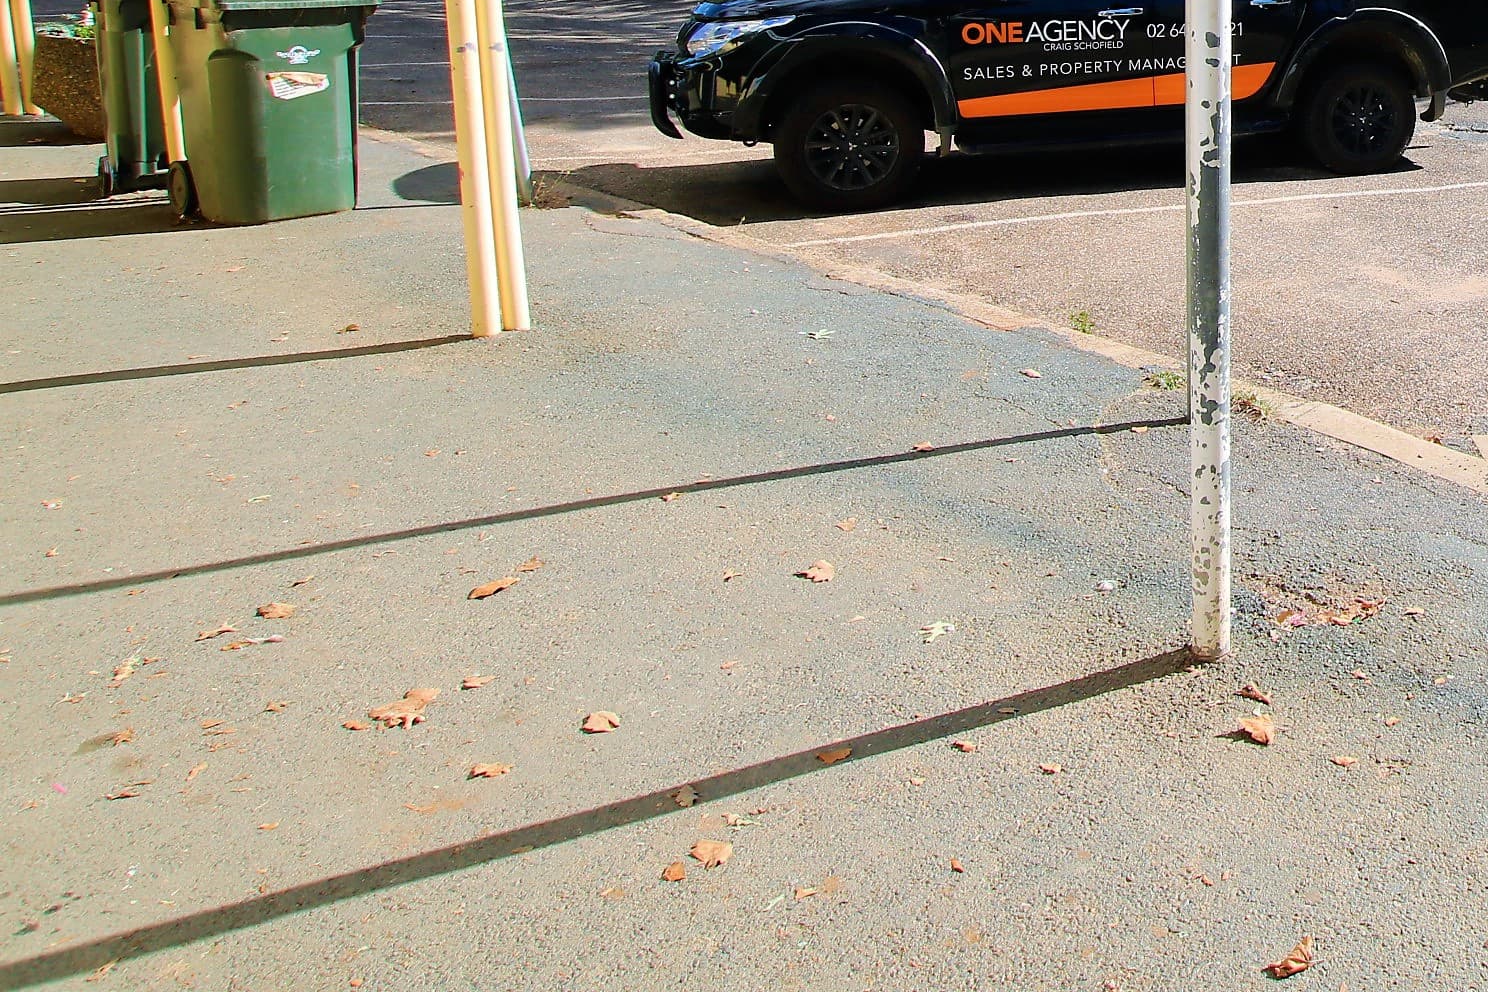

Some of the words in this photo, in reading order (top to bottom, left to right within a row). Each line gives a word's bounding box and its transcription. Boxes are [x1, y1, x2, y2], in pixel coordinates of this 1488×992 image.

[961, 22, 1024, 45] ONE
[1025, 19, 1130, 44] AGENCY
[1146, 23, 1166, 38] 02
[1169, 22, 1186, 38] 64
[1043, 41, 1072, 52] CRAIG
[1073, 40, 1124, 51] SCHOFIELD
[963, 65, 1015, 80] SALES
[1021, 63, 1033, 77] &
[1039, 59, 1123, 76] PROPERTY
